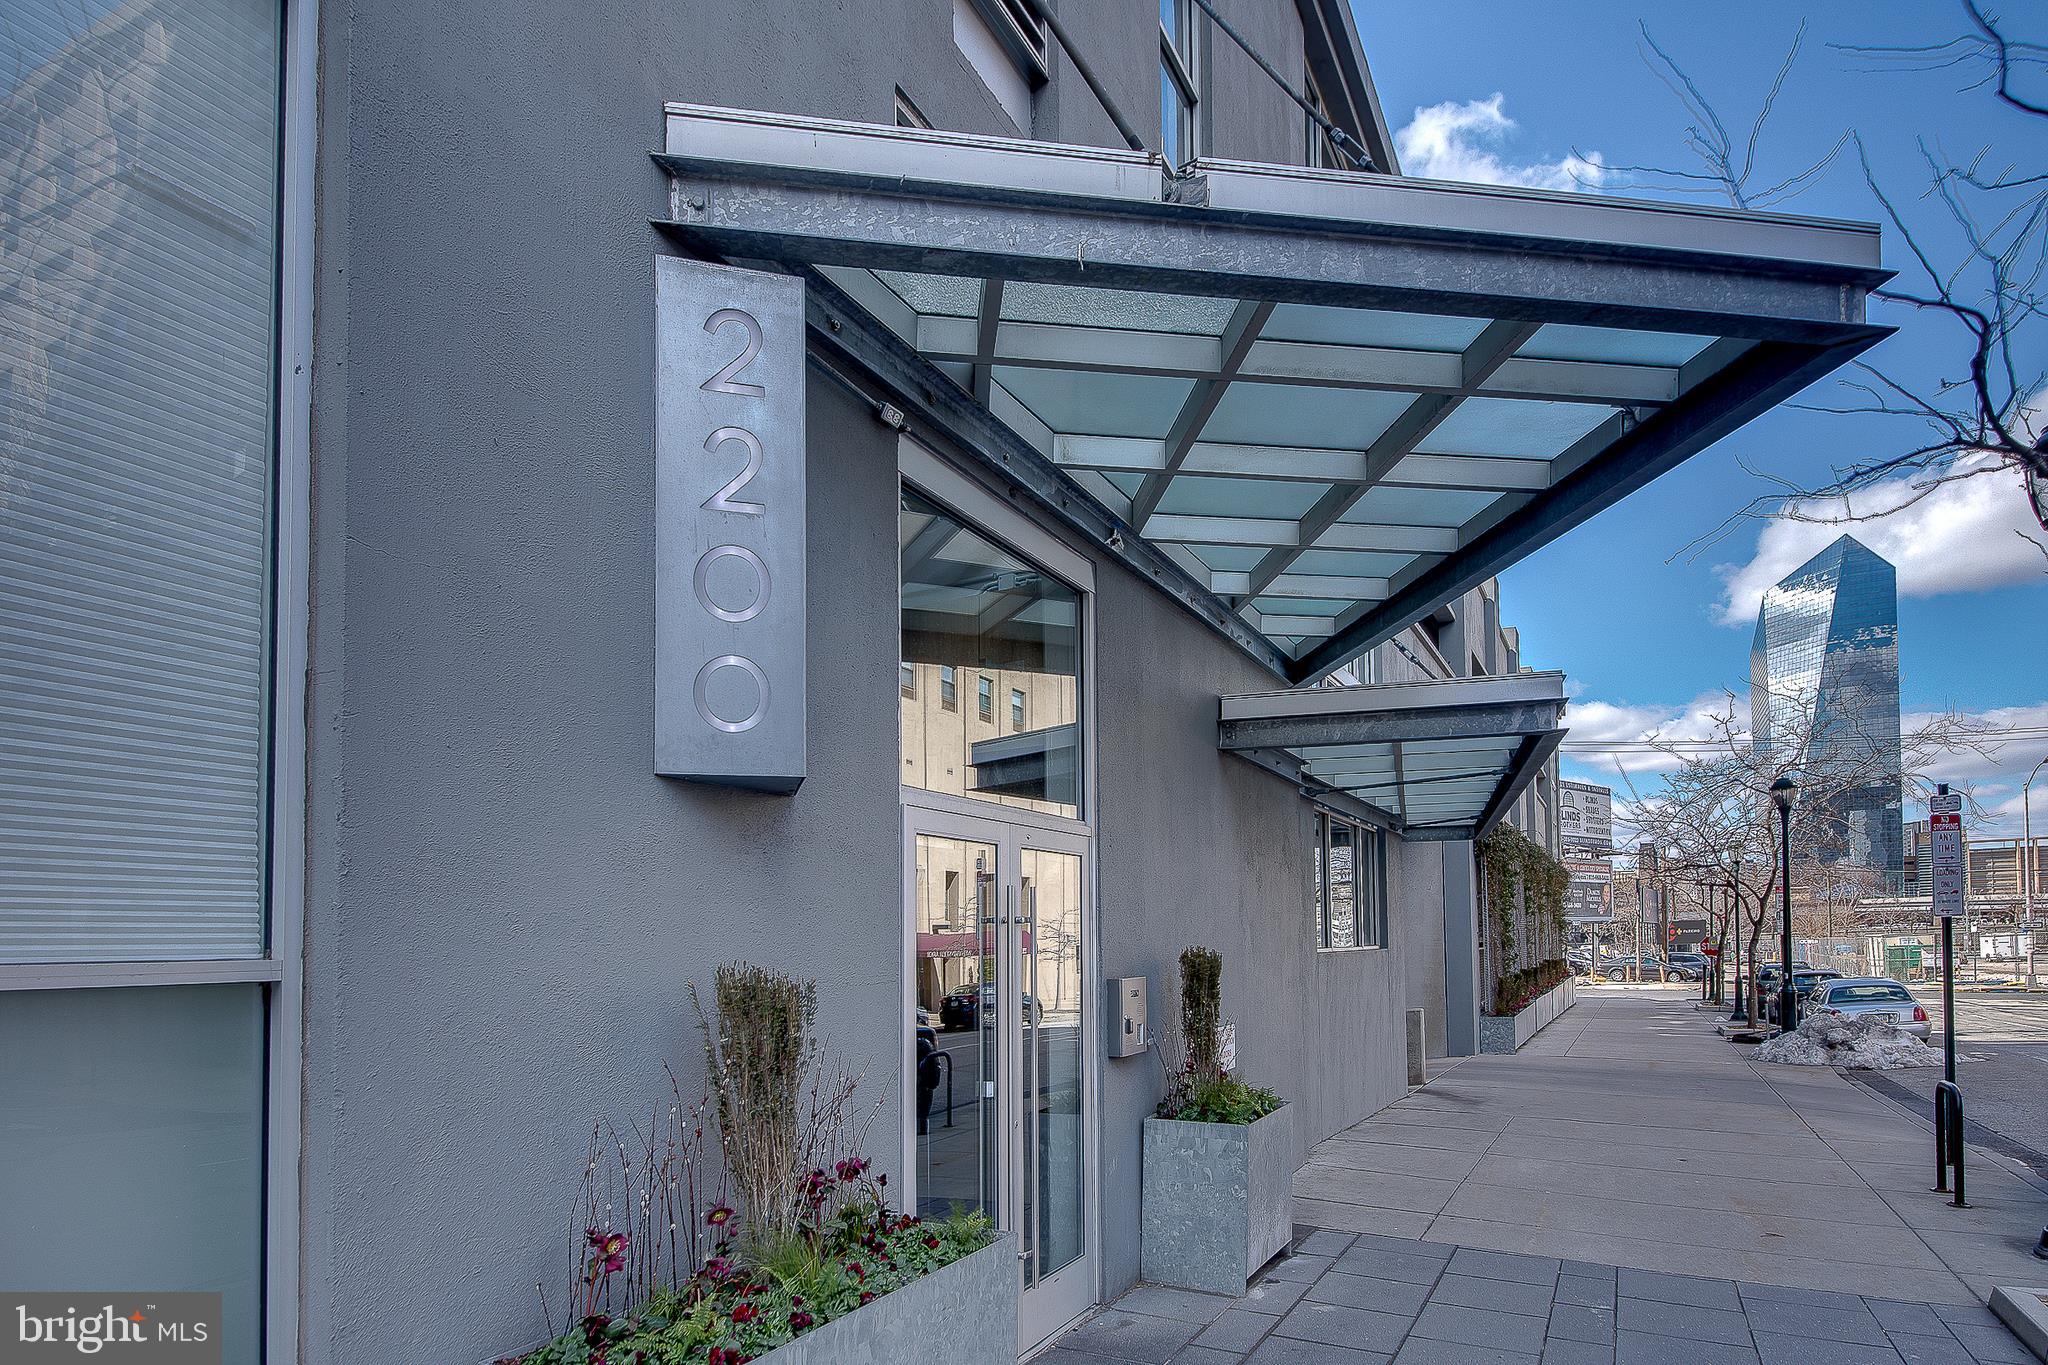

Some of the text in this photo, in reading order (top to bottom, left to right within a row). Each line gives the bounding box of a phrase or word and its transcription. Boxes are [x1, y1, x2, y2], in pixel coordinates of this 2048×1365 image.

[692, 308, 772, 733] 2200
[1561, 810, 1581, 822] LINDS
[1561, 821, 1581, 829] OTHERS
[1933, 823, 1959, 831] STOPPING
[1938, 833, 1953, 841] ANY
[1937, 844, 1956, 853] TIME
[1936, 868, 1959, 876] LOADING
[1940, 880, 1954, 888] ONLY
